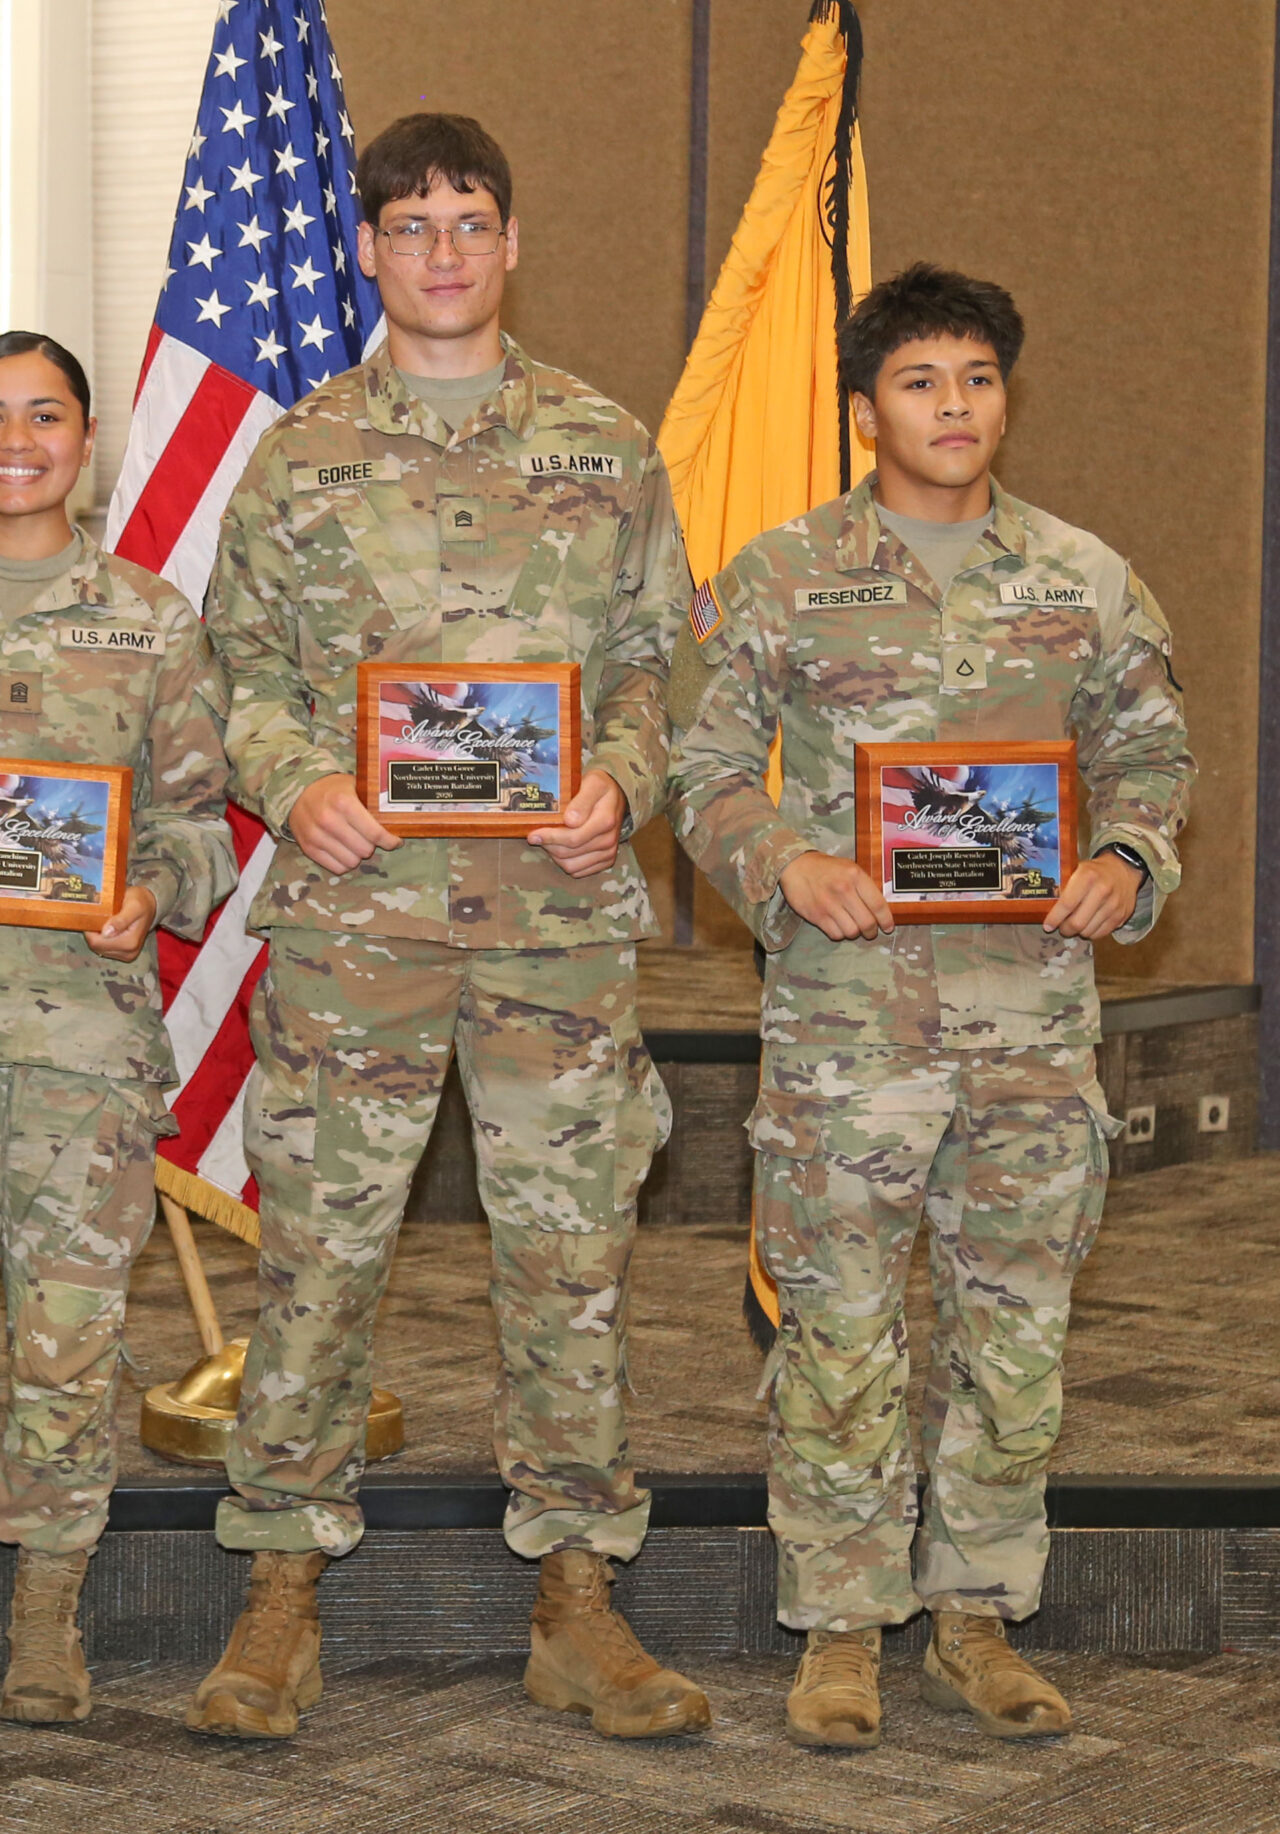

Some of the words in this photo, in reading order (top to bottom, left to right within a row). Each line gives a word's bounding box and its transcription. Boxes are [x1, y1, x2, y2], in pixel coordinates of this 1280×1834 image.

[318, 462, 373, 485] GOREE
[808, 586, 894, 606] RESENDEZ
[393, 719, 458, 744] Award
[454, 729, 536, 757] Excellence
[460, 773, 495, 782] University
[897, 804, 960, 831] Award
[956, 814, 1036, 843] Excellence
[0, 819, 82, 844] Excellence
[929, 852, 952, 861] Joseph
[2, 861, 36, 870] University
[963, 861, 997, 869] University
[954, 870, 984, 878] Battalion
